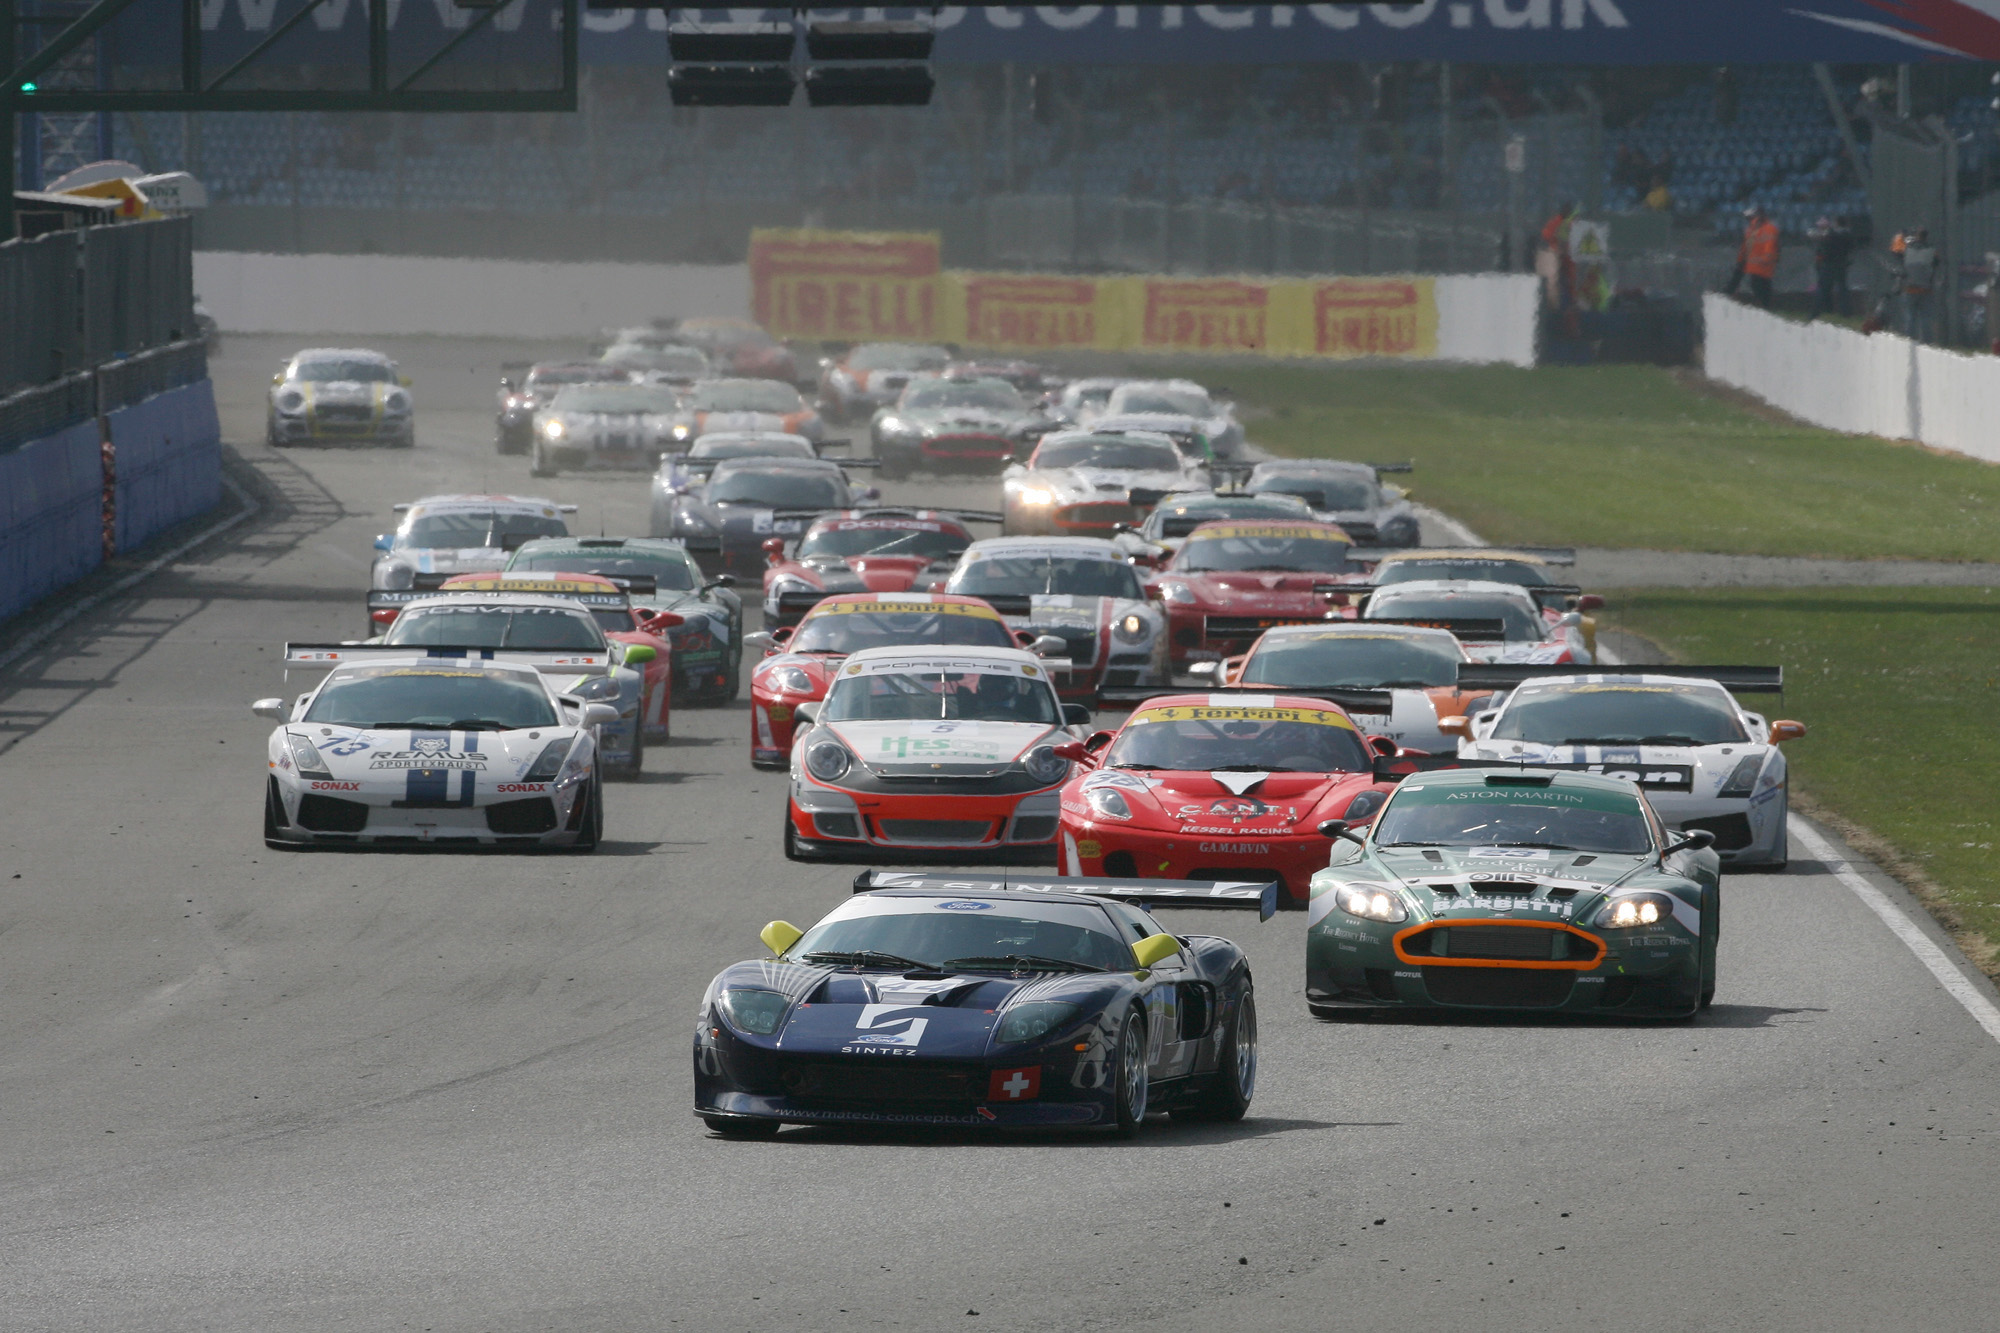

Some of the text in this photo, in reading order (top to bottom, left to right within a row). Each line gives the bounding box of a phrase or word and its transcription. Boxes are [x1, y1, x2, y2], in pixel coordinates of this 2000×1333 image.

[838, 520, 940, 532] DODGE
[553, 593, 621, 605] Rcing
[853, 603, 944, 612] Ferrari
[872, 661, 1012, 671] PORSCHE
[1190, 707, 1301, 721] Ferrari
[370, 751, 488, 761] REMUS
[377, 761, 480, 769] SPORTEXHAUST
[311, 781, 360, 791] SONAX
[497, 784, 546, 792] SONAX
[1446, 791, 1583, 803] ASTON MARTIN
[1180, 804, 1297, 815] CANTI
[1180, 826, 1236, 834] KESSEL
[1199, 842, 1270, 854] GAMARVIN
[943, 882, 1188, 897] SINTEZ
[1432, 899, 1574, 916] BARBETTI
[1394, 970, 1422, 978] MOTUL
[841, 1046, 917, 1056] SINTEZ
